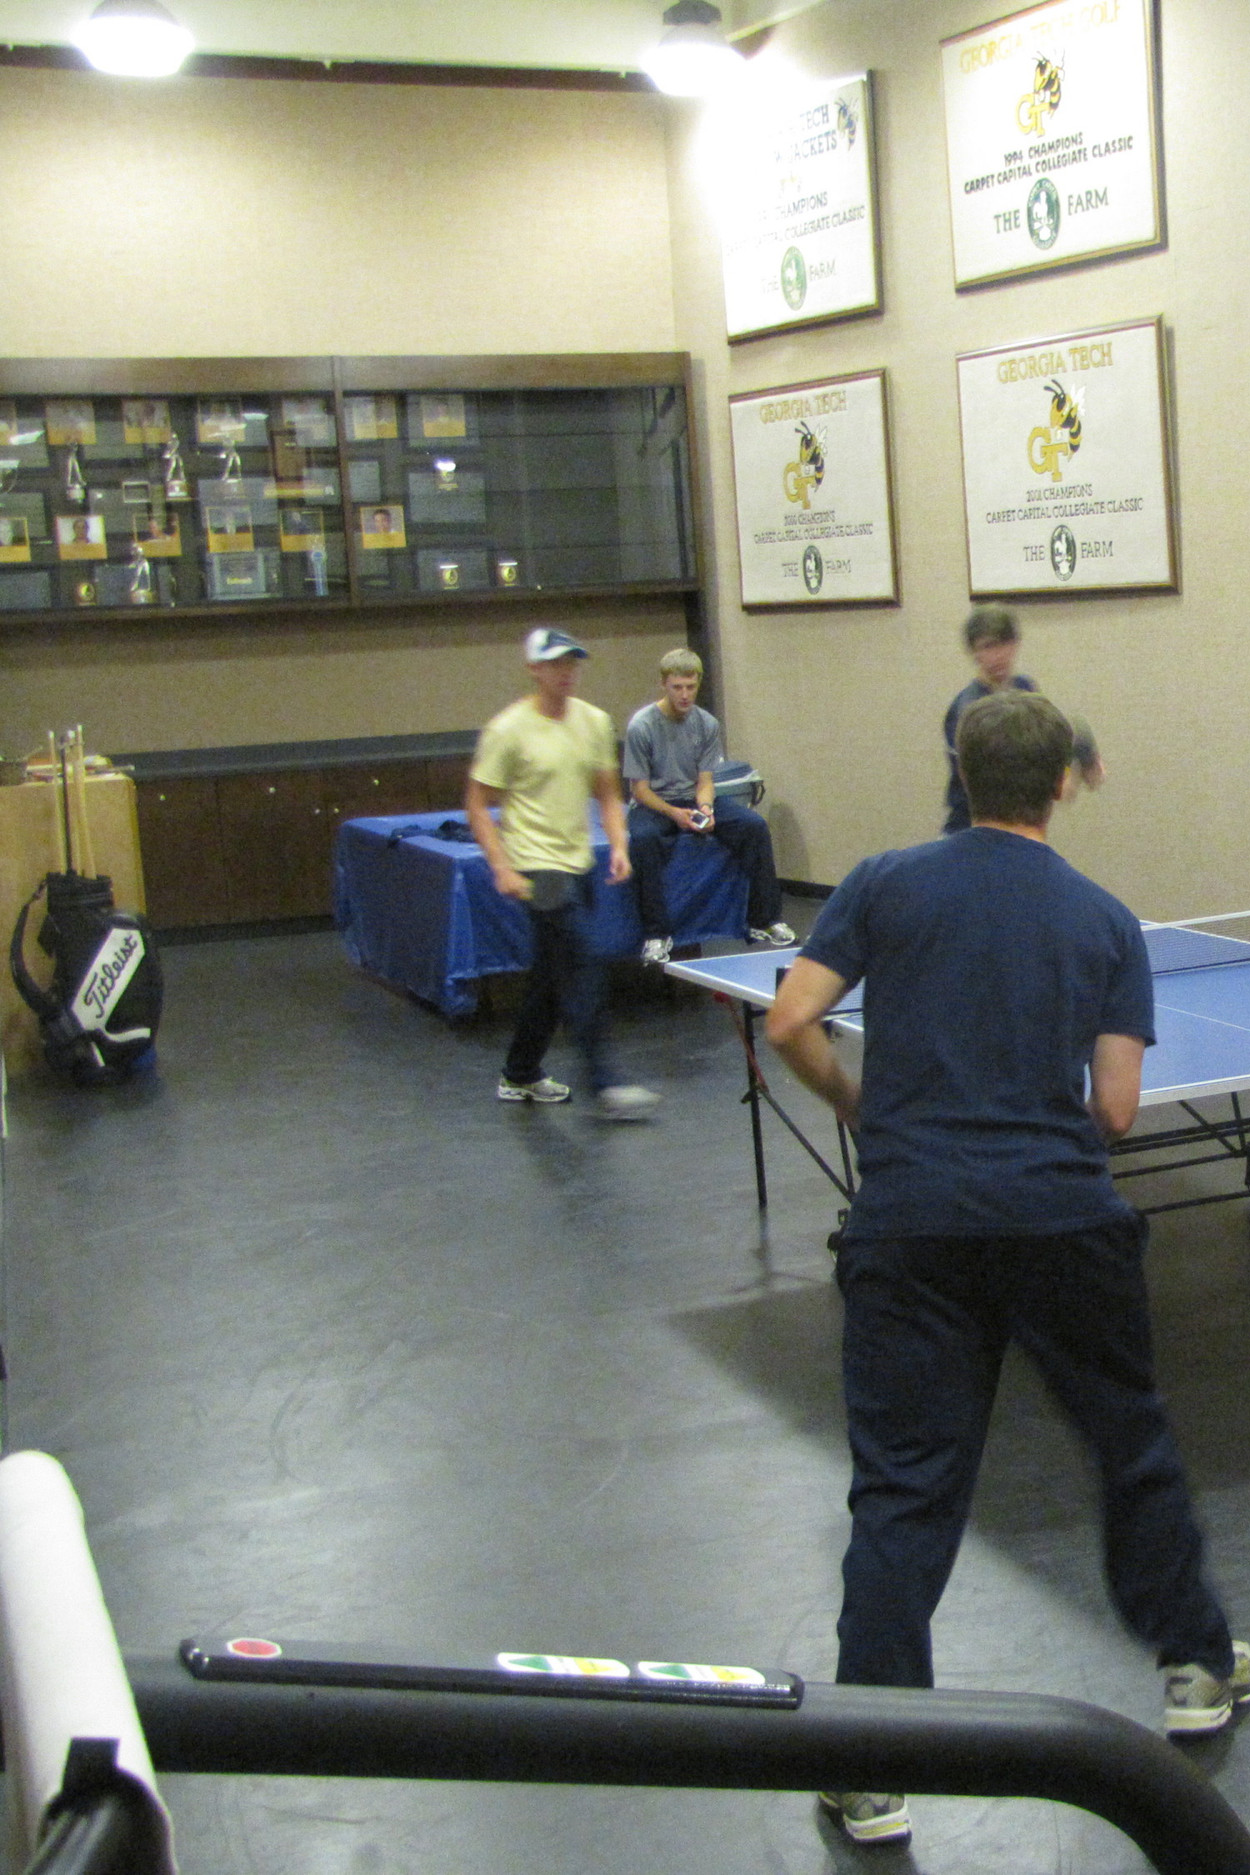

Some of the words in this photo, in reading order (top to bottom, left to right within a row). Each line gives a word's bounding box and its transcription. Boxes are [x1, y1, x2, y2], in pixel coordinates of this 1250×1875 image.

[964, 174, 995, 194] CARPET
[997, 164, 1032, 184] CAPITAL
[1035, 148, 1088, 173] COLLEGIATE
[1092, 135, 1134, 158] CLASSIC
[1004, 150, 1023, 167] 1994
[1028, 132, 1083, 159] CHAMPIONS
[994, 209, 1020, 234] THE
[1067, 187, 1109, 216] FARM
[997, 352, 1067, 383] GEORGIA
[1068, 342, 1114, 371] TECH
[760, 399, 813, 424] GEORGIA
[814, 390, 848, 416] TECH
[1043, 484, 1093, 501] CHAMPIONS
[986, 510, 1016, 524] CARPET
[1017, 507, 1051, 521] CAPITAL
[1053, 501, 1105, 518] COLLEGIATE
[1107, 498, 1144, 513] CLASSIC
[782, 563, 799, 577] THE
[825, 560, 851, 574] FARM
[1023, 545, 1045, 562] THE
[1081, 541, 1114, 558] FARM
[83, 935, 138, 1019] Titleist
